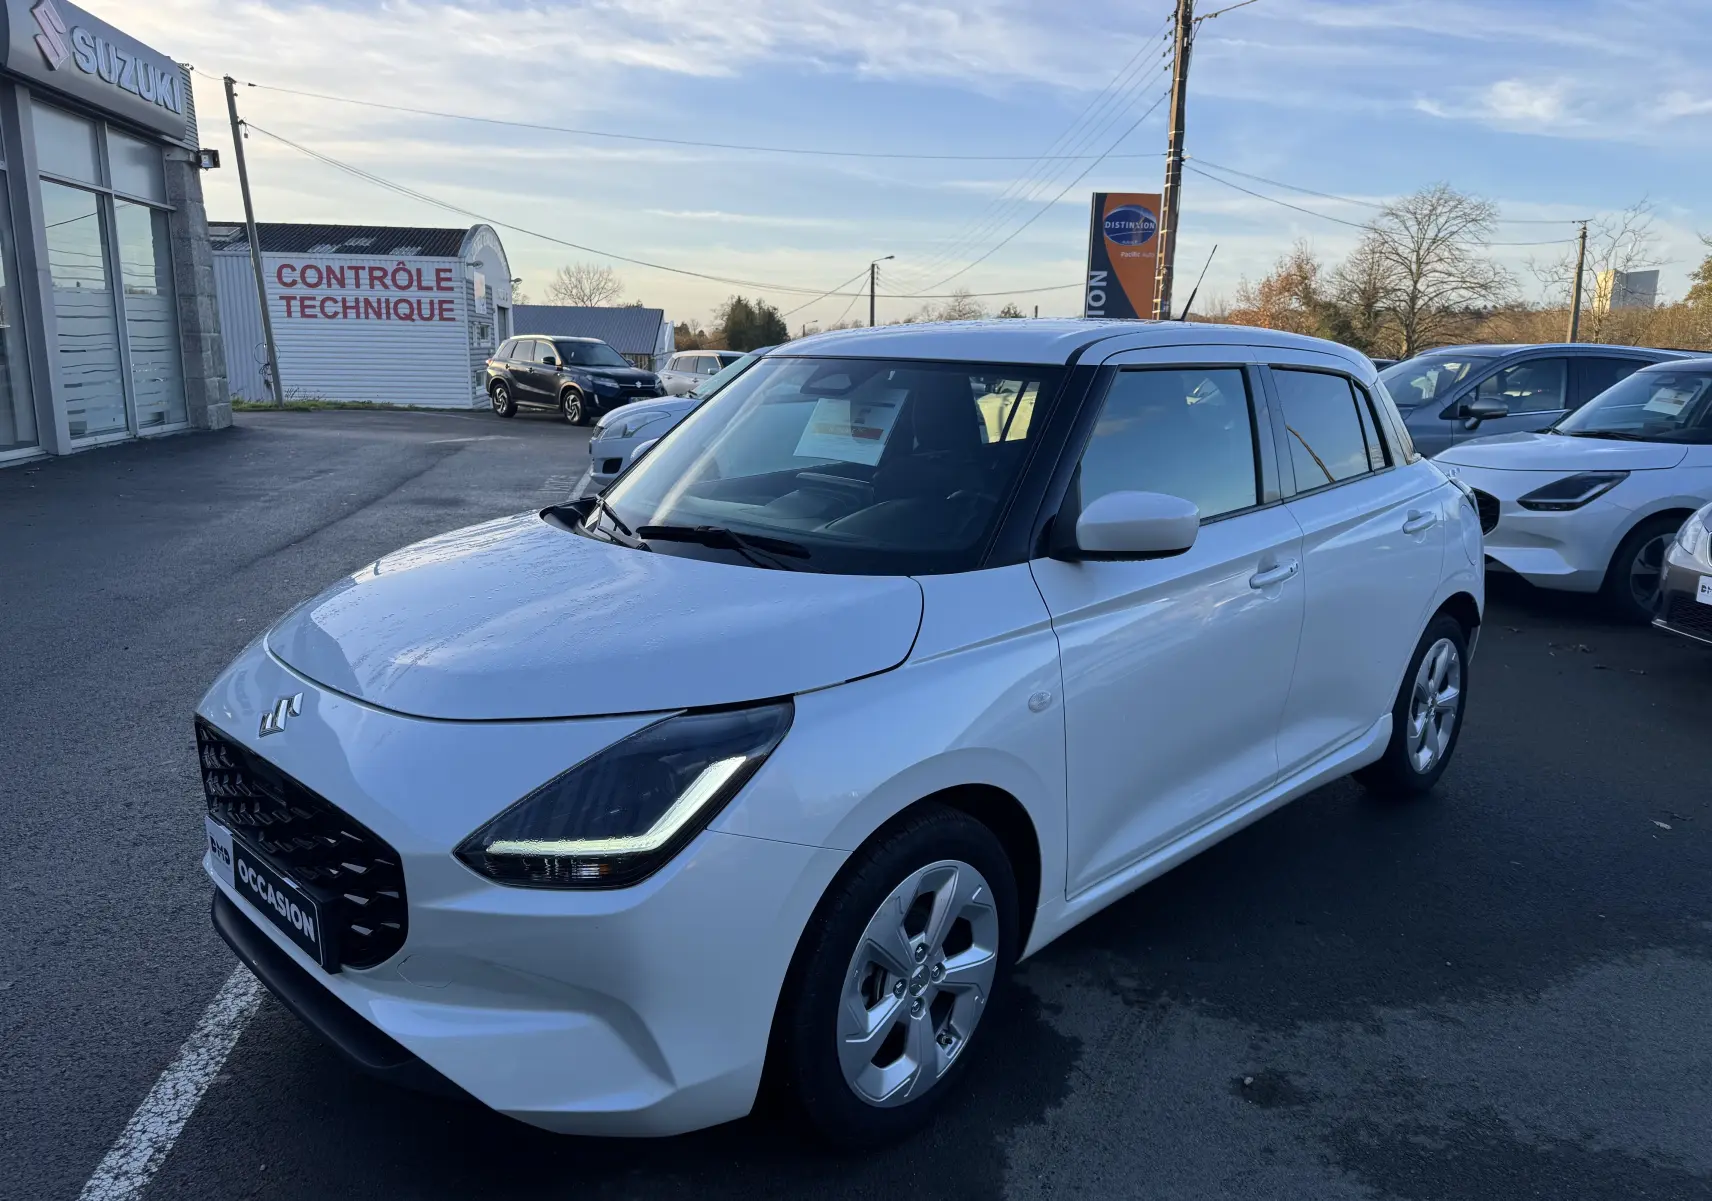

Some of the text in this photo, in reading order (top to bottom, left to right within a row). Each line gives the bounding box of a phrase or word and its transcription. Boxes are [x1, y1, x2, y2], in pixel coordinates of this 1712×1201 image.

[71, 26, 182, 115] SUZUKI
[1104, 221, 1155, 229] DISTINXION
[276, 261, 455, 292] CONTRÔLE
[278, 295, 457, 323] TECHNIQUE
[237, 858, 316, 943] OCCASION
